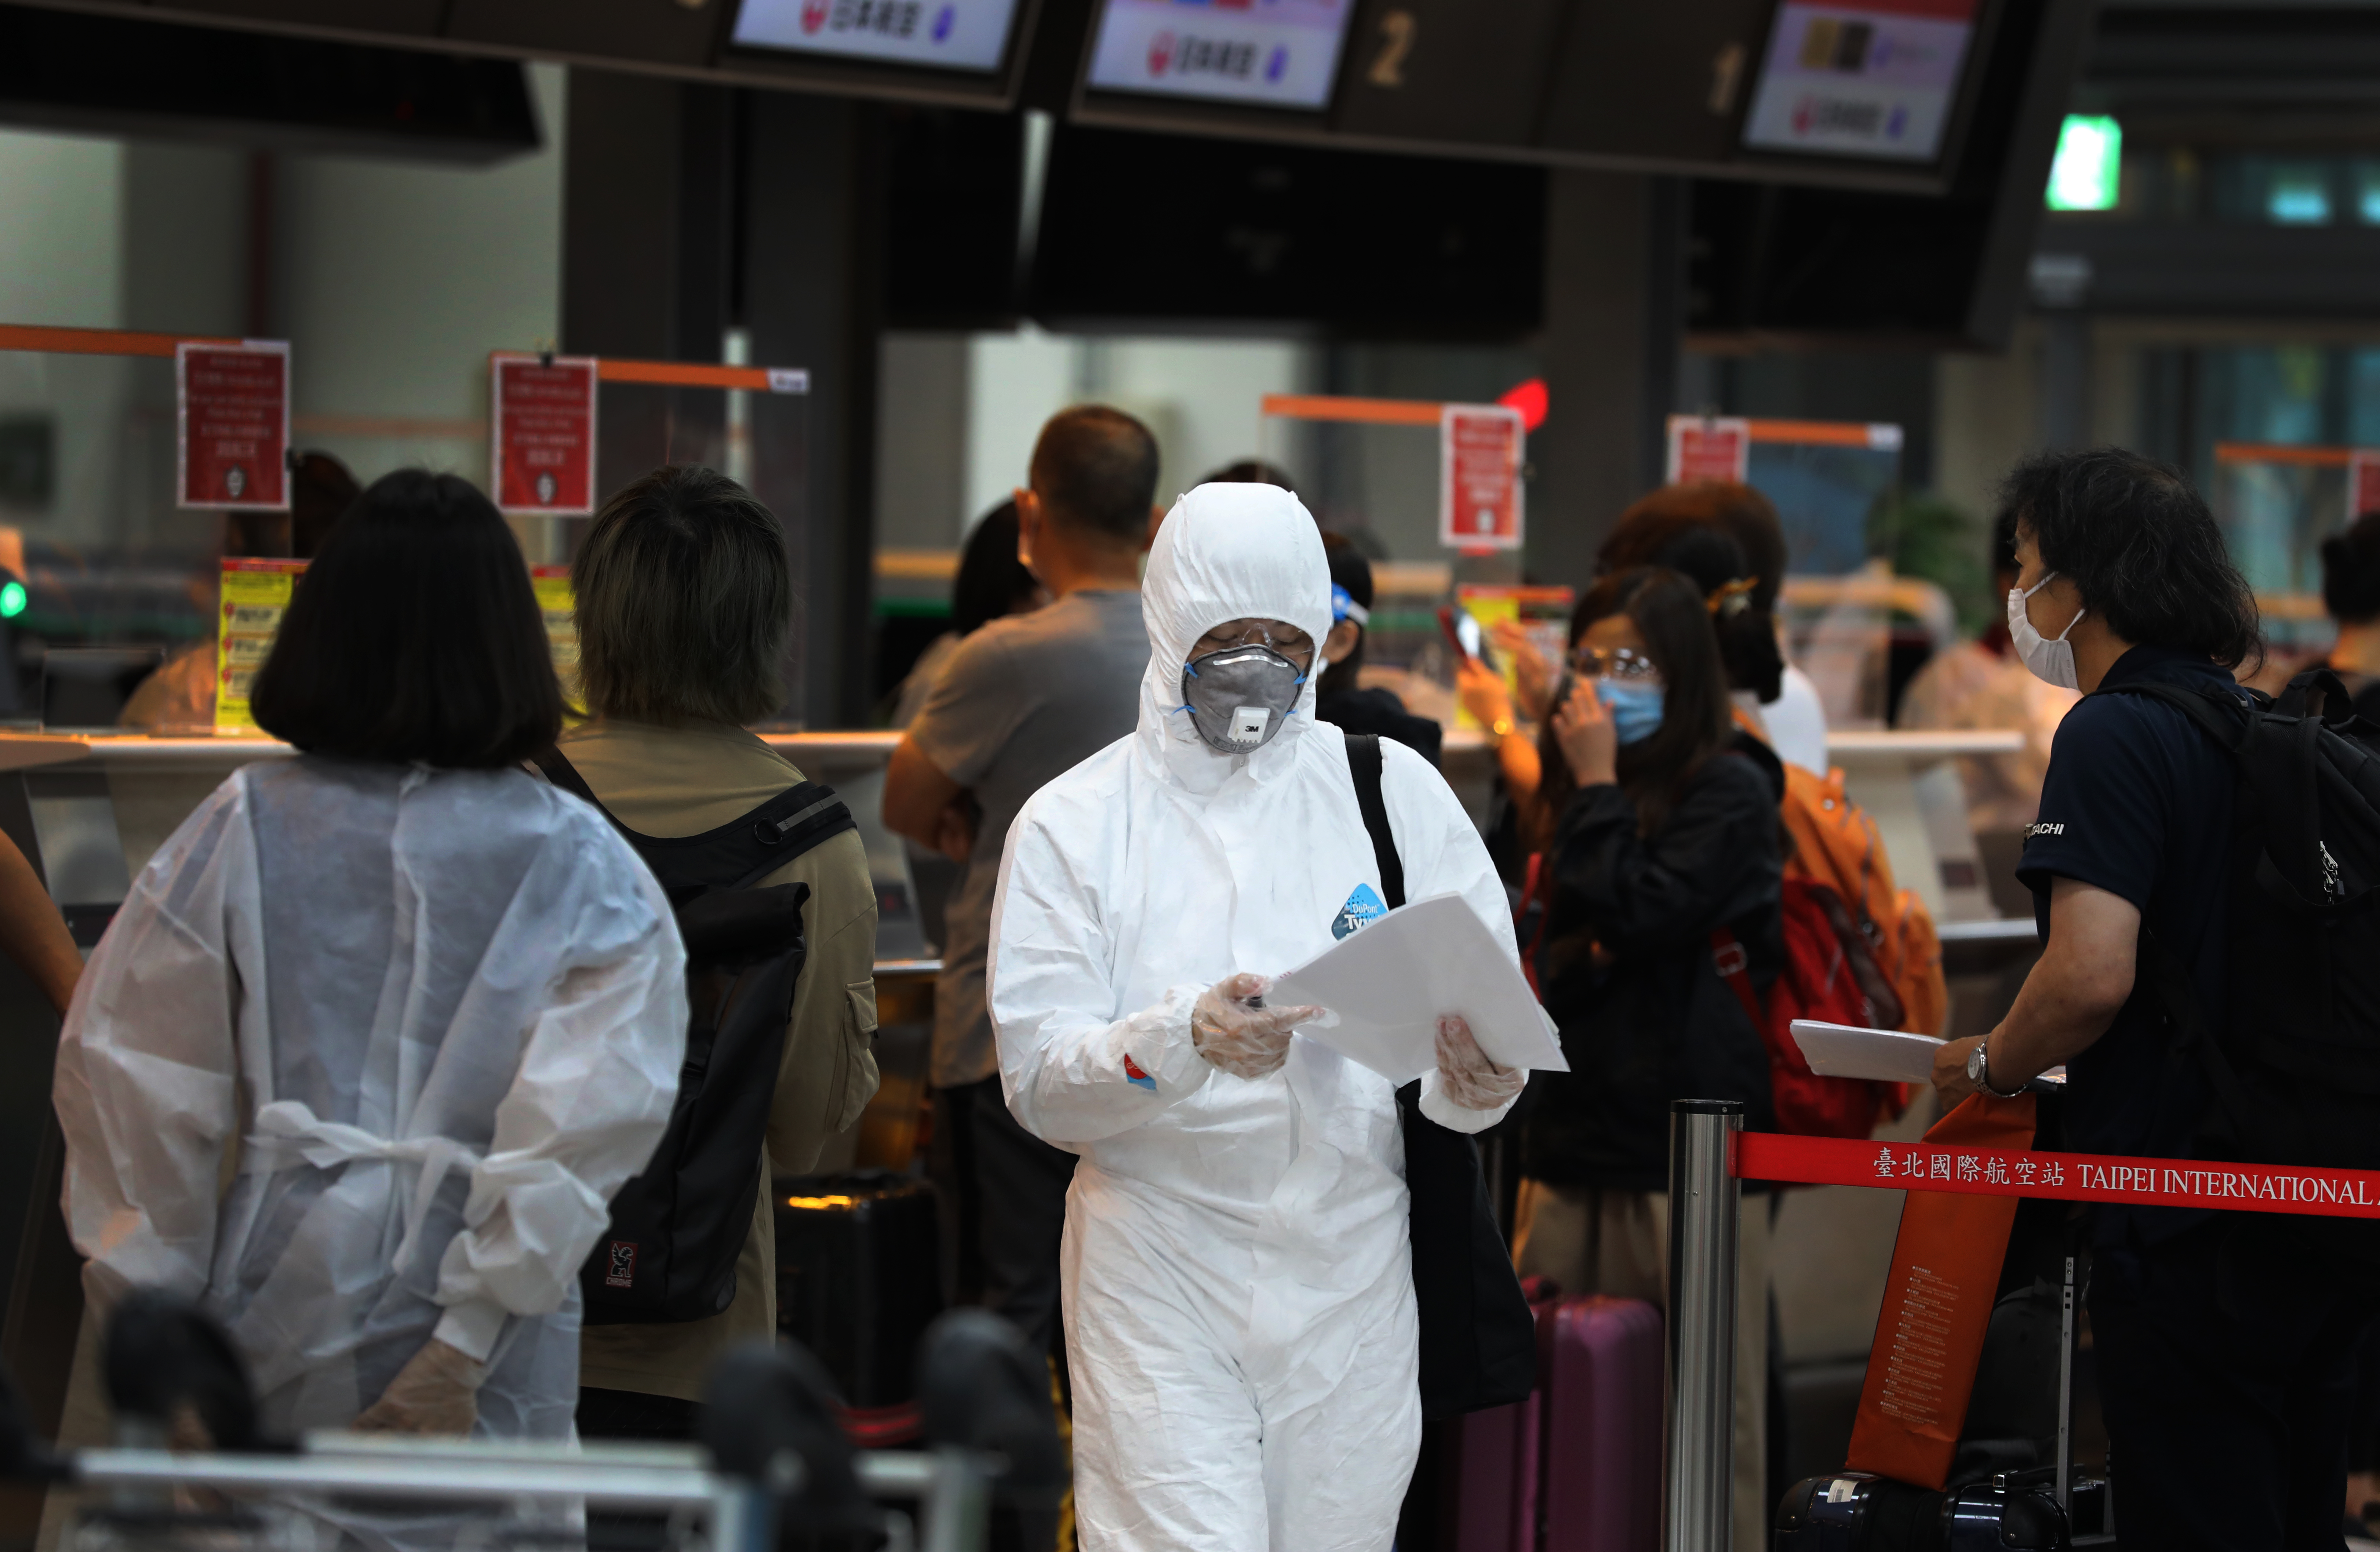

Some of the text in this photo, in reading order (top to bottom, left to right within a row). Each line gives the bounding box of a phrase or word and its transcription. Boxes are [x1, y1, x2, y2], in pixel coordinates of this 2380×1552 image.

[1368, 10, 1415, 85] 2
[1707, 43, 1746, 114] 1
[2031, 823, 2065, 836] TACHI
[1874, 1147, 2065, 1187] 臺北國際航空站
[2078, 1164, 2157, 1192] TAIPEI
[2163, 1169, 2373, 1205] INTERNATIONAL
[606, 1277, 632, 1287] CHROME
